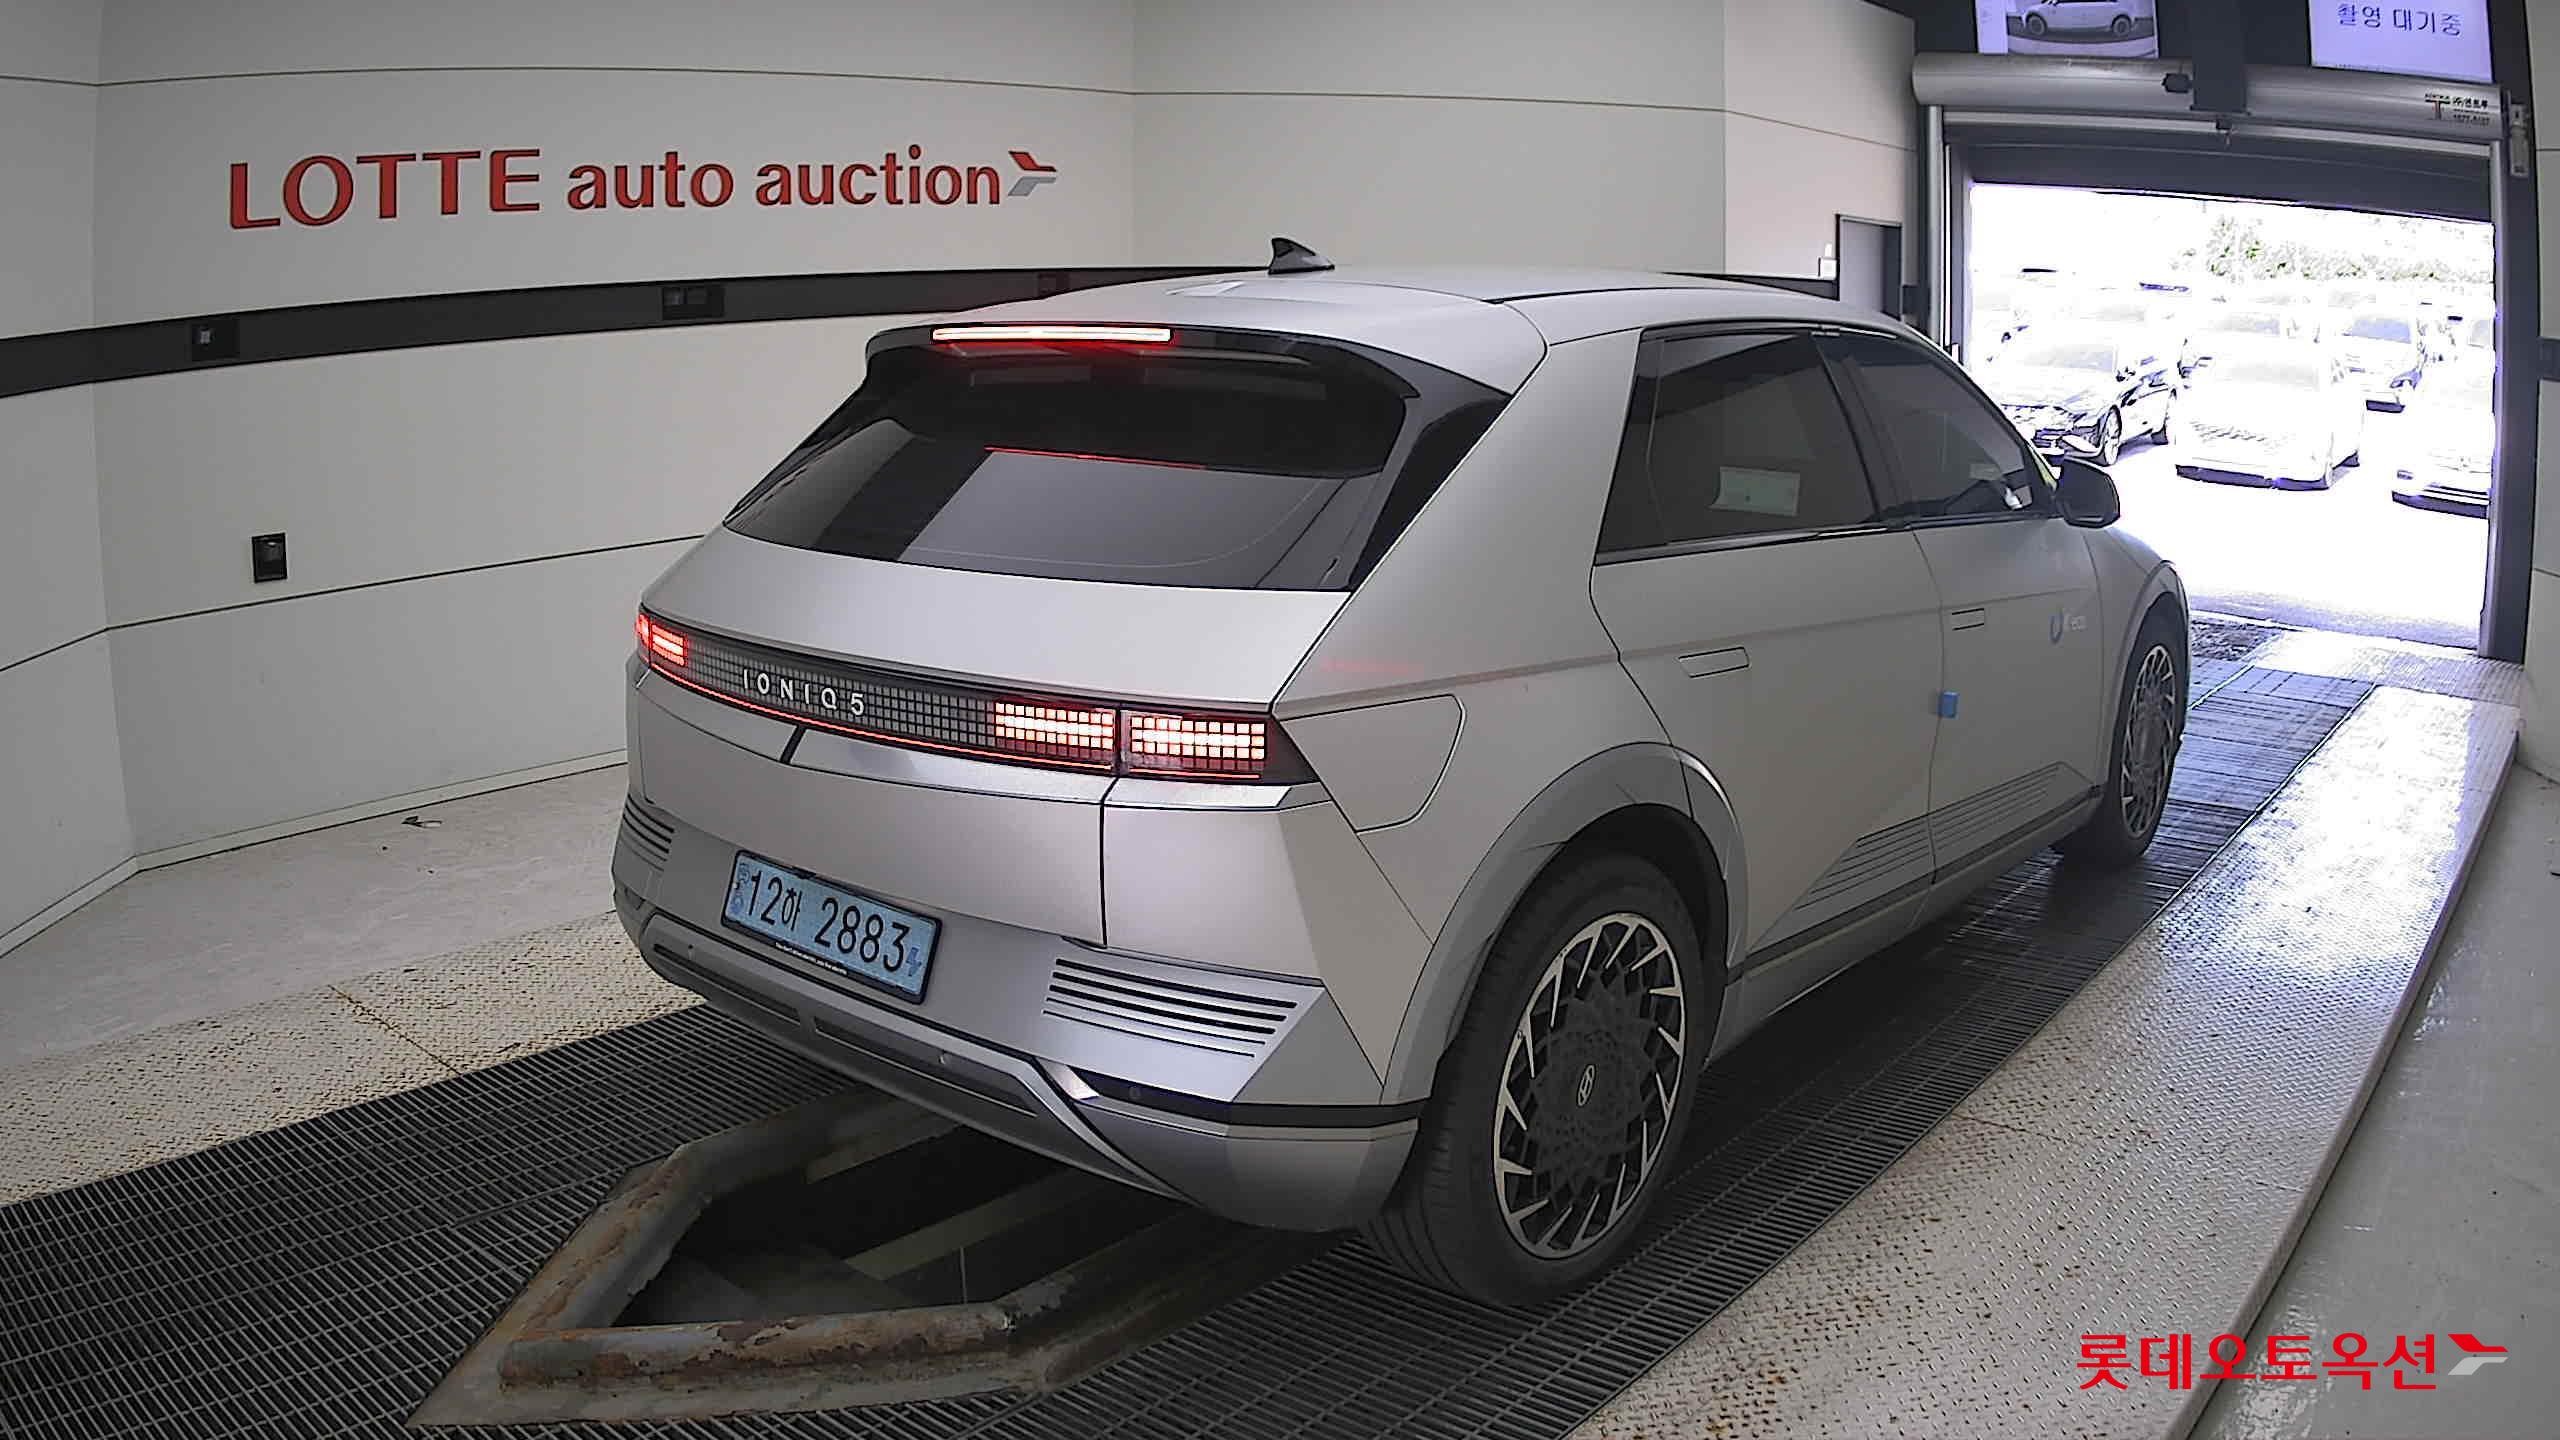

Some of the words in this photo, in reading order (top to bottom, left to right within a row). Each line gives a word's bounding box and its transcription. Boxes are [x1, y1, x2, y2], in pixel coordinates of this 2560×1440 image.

[2338, 3, 2381, 28] 촬영
[2392, 8, 2461, 36] 대기중
[229, 149, 541, 229] LOTTE
[567, 151, 734, 209] auto
[756, 144, 1001, 207] auction
[743, 669, 837, 710] IONIQ
[850, 692, 864, 715] 5
[748, 870, 803, 932] 12하
[813, 897, 910, 973] 2883
